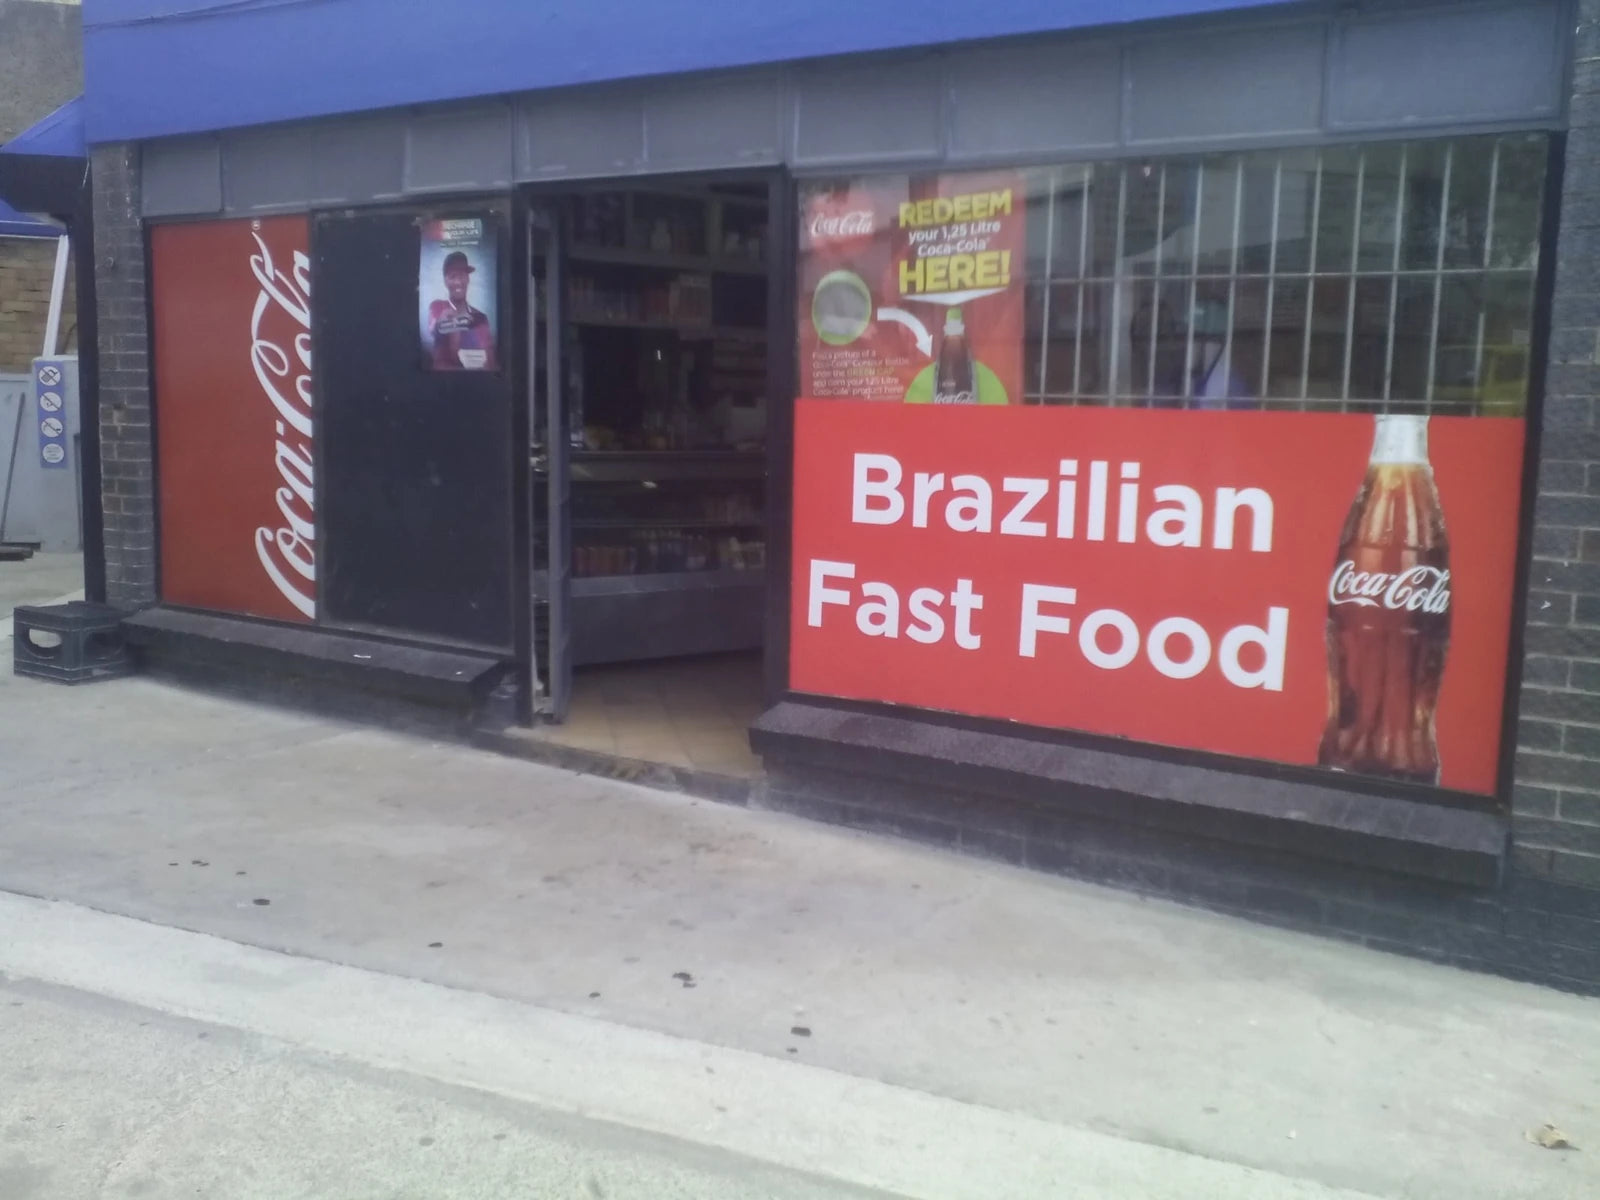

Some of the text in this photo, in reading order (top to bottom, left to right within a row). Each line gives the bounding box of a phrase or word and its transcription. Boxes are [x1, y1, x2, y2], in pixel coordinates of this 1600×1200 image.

[811, 210, 873, 237] Coca-Cola
[899, 188, 1012, 229] REDEEM
[908, 229, 939, 246] your
[970, 221, 1001, 235] Litre
[899, 250, 1012, 294] HERE!
[851, 452, 1275, 553] Brazilian
[1329, 560, 1450, 614] Coca-Cola
[807, 558, 1290, 693] Fast Food
